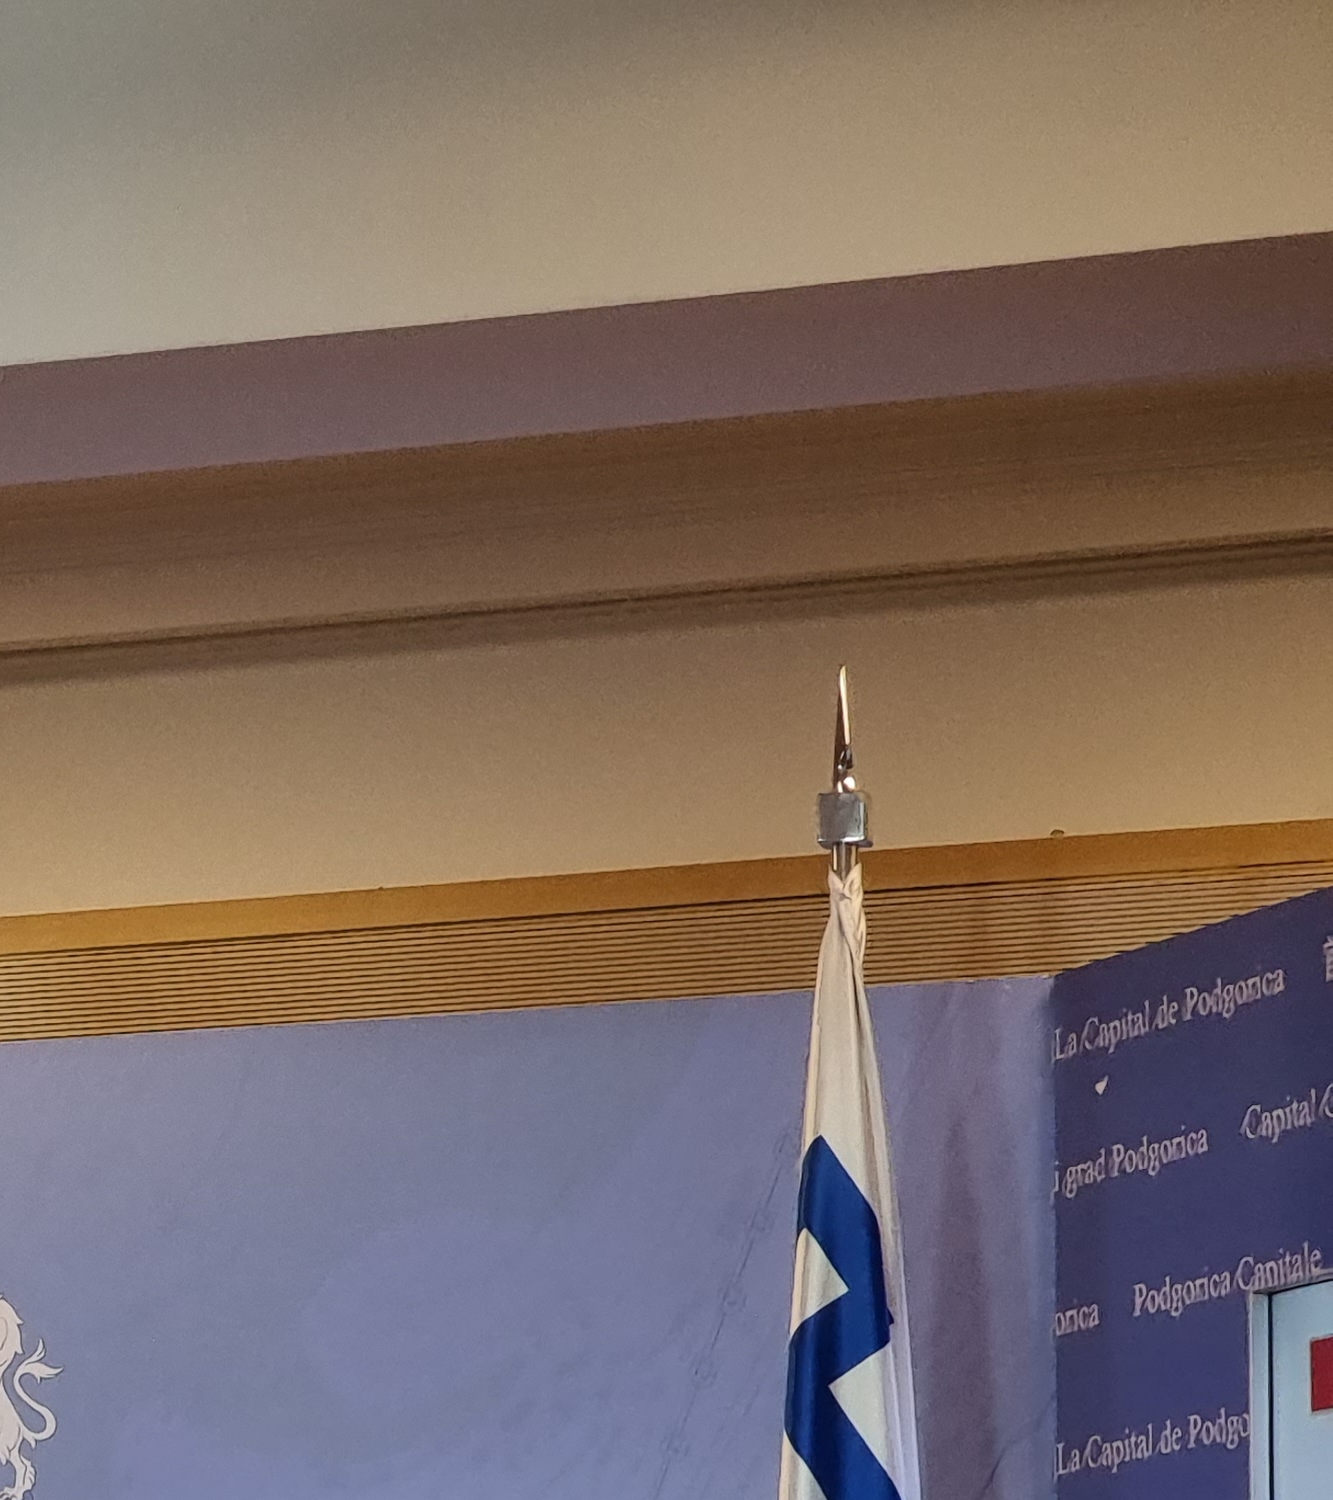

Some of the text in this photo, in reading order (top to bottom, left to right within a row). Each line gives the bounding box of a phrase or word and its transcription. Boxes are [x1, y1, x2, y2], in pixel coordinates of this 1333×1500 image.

[1080, 1000, 1150, 1054] Capital
[1153, 994, 1179, 1029] de
[1183, 966, 1286, 1022] Podgorica
[1061, 1147, 1106, 1200] grad
[1110, 1124, 1209, 1178] Podgorica
[1240, 1088, 1316, 1143] Capital
[1132, 1267, 1231, 1317] Podgorica
[1084, 1422, 1153, 1474] Capital
[1156, 1419, 1182, 1454] de
